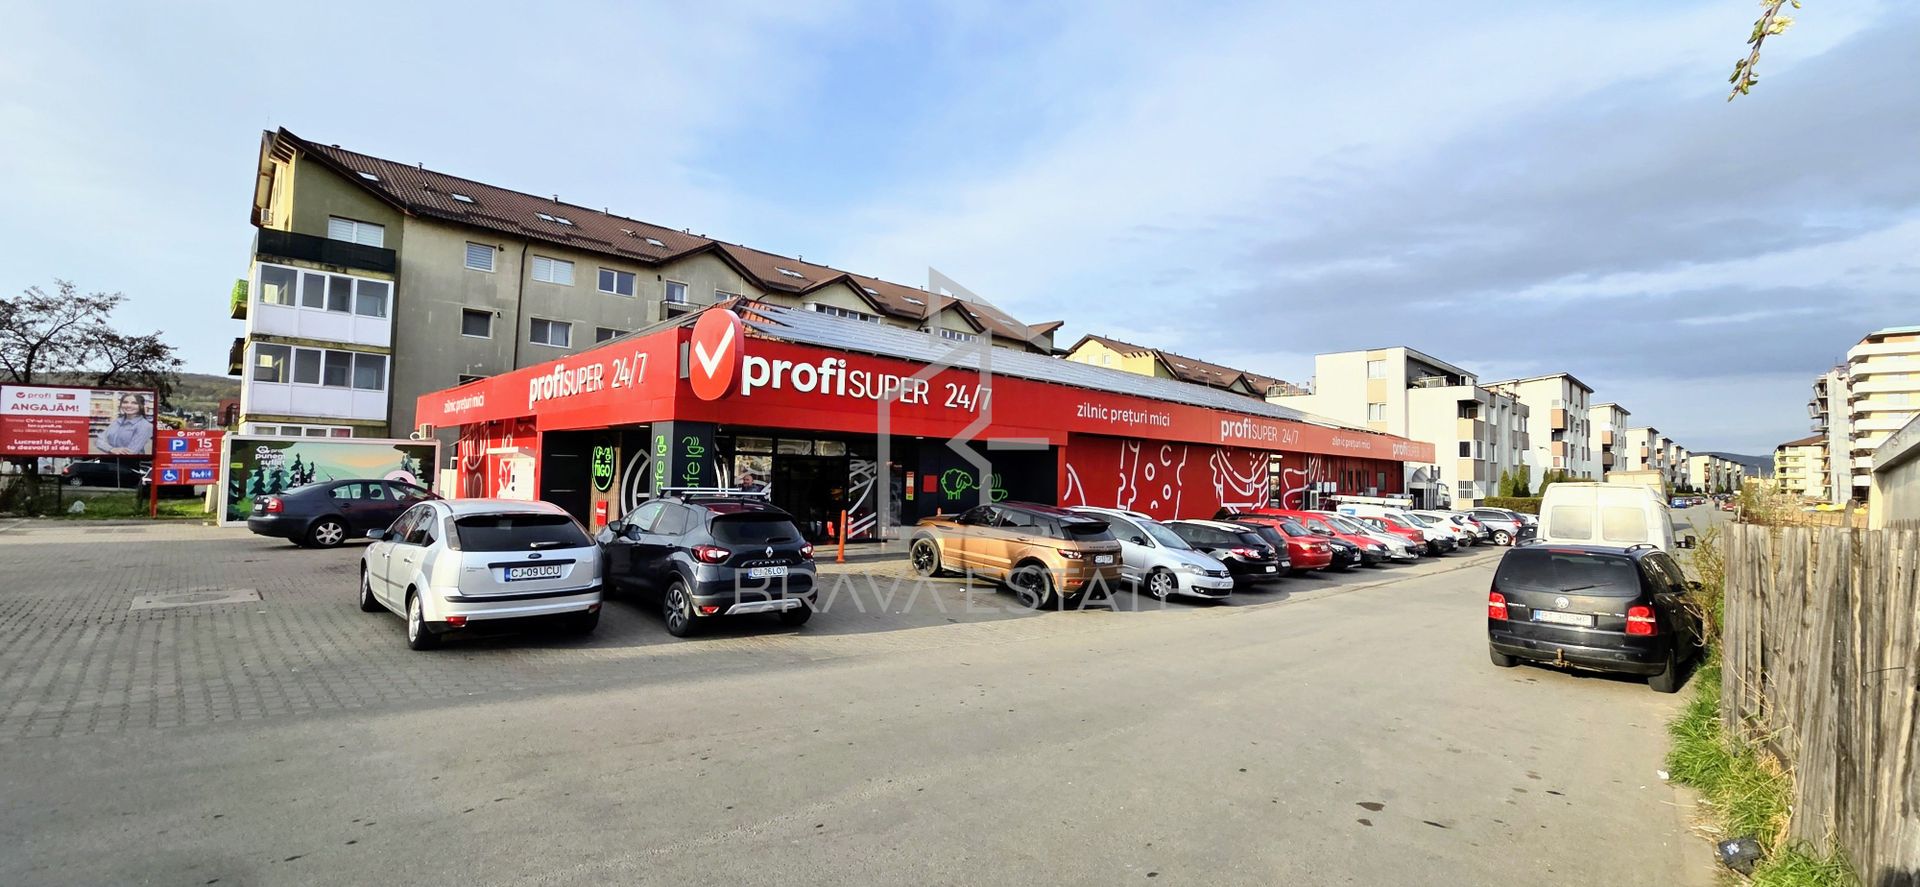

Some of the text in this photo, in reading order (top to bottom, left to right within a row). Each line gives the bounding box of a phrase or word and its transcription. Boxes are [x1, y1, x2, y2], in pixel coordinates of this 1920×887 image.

[611, 351, 648, 389] 24/7
[944, 383, 993, 412] 24/7
[11, 402, 79, 412] ANGAJĂM!
[1077, 402, 1170, 432] zilnic prețuri mici
[197, 438, 213, 449] 15
[1282, 429, 1299, 445] 24/7
[540, 566, 559, 575] UCU
